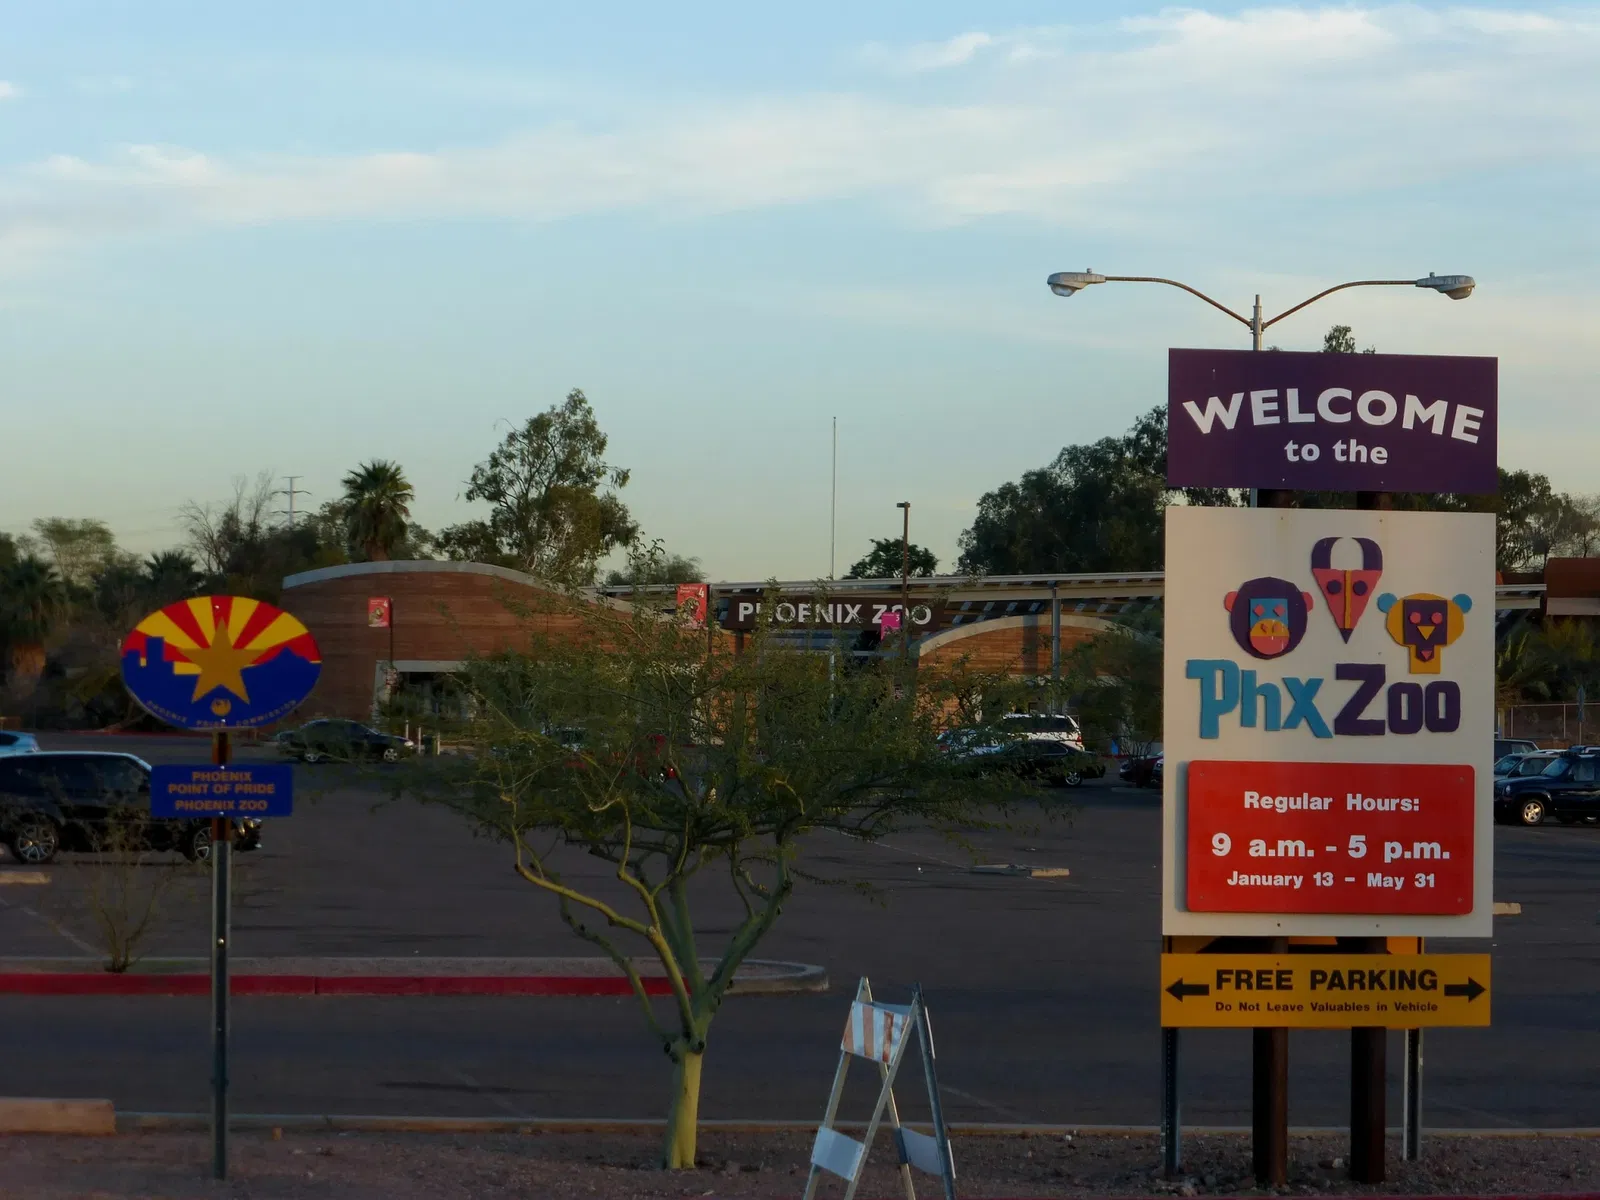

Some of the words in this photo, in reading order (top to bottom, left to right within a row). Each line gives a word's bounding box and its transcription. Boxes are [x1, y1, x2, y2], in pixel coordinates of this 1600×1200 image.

[1182, 387, 1484, 444] WELCOME
[1284, 440, 1320, 462] to
[1332, 439, 1388, 465] the
[698, 587, 705, 598] 4
[192, 771, 252, 782] PHOENIX
[168, 783, 209, 794] POINT
[213, 783, 231, 794] OF
[235, 783, 275, 794] PRIDE
[175, 799, 235, 811] PHOENIX
[239, 799, 268, 811] ZOO
[1244, 791, 1333, 813] Regular
[1347, 794, 1420, 812] Hours:
[1211, 832, 1232, 857] 9
[1248, 838, 1315, 858] a.m.
[1347, 835, 1367, 859] 5
[1384, 841, 1450, 863] p.m.
[1227, 871, 1304, 890] January
[1313, 872, 1334, 887] 13
[1367, 873, 1405, 891] May
[1414, 873, 1435, 888] 31
[1216, 969, 1294, 991] FREE
[1310, 969, 1438, 991] PARKING
[1215, 1001, 1232, 1012] Do
[1238, 1001, 1260, 1012] Not
[1266, 1001, 1304, 1012] Leave
[1309, 1001, 1370, 1012] Valuables
[1376, 1001, 1388, 1012] in
[1393, 1001, 1439, 1012] Vehicle
